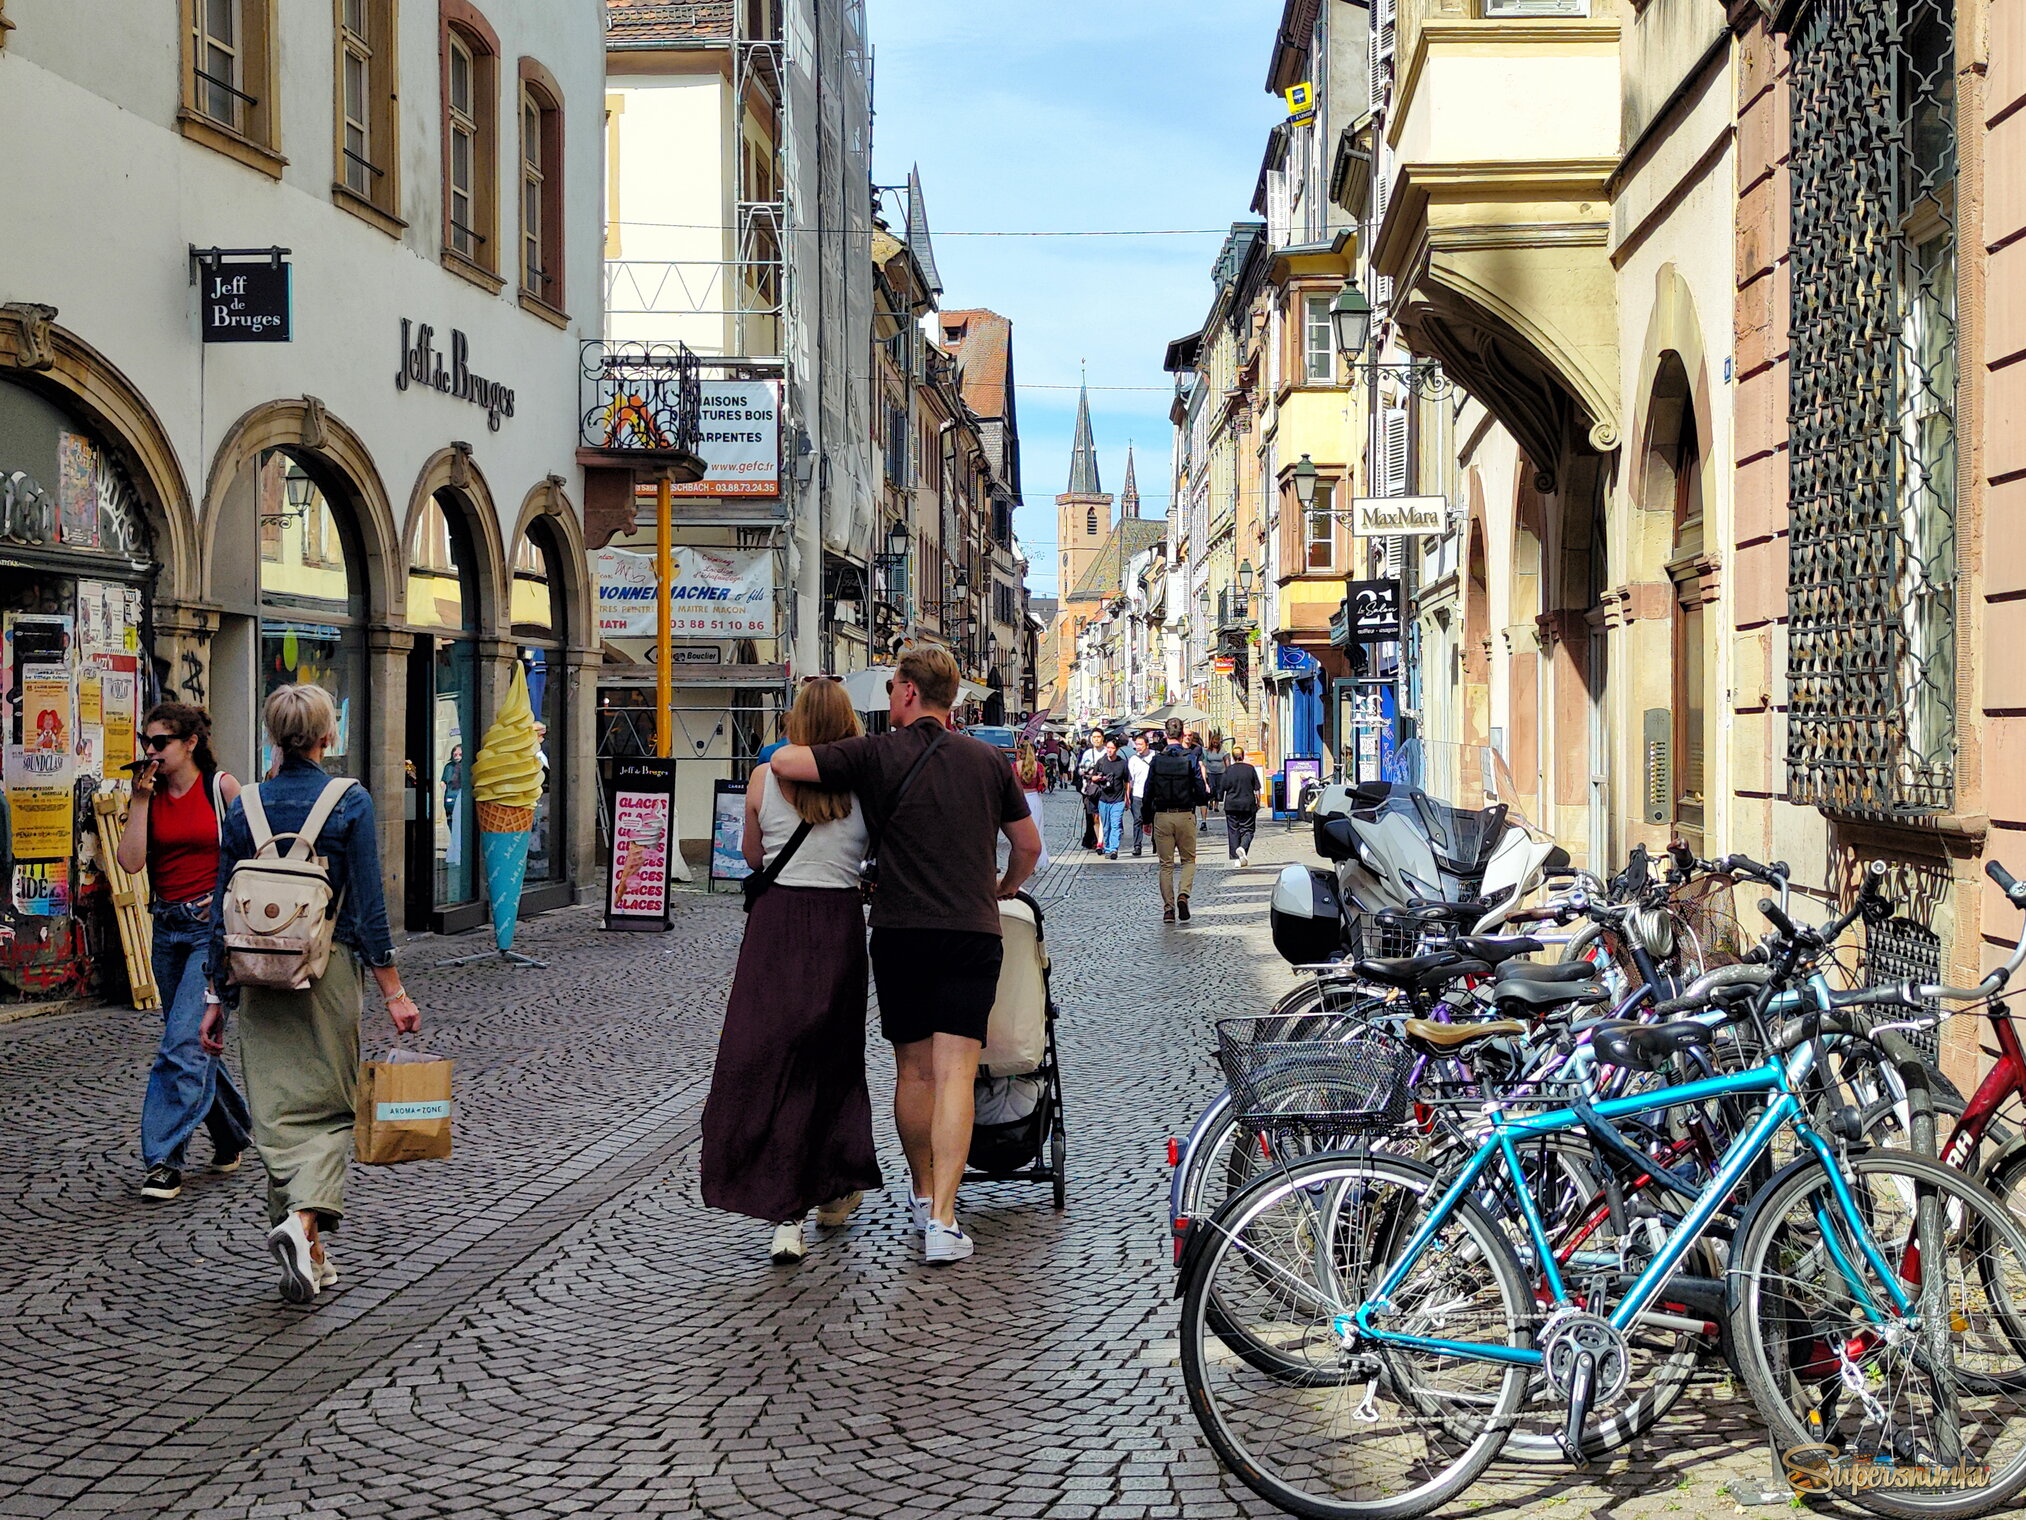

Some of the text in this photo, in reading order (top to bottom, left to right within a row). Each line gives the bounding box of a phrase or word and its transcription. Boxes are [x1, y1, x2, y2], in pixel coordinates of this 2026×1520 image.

[211, 275, 248, 299] Jeff
[230, 298, 246, 310] de
[211, 305, 281, 332] Bruges
[396, 317, 515, 432] Jeff de Bruges
[744, 410, 773, 421] BOIS
[711, 461, 775, 473] www.gefc.fr
[715, 484, 775, 492] 03.88.73.24.35
[1361, 506, 1440, 526] MaxMara
[690, 620, 705, 629] 88
[710, 620, 723, 629] 51
[729, 621, 742, 630] 10
[748, 621, 764, 630] 86
[620, 766, 635, 775] Jeff
[642, 765, 669, 777] Bruges
[615, 899, 662, 910] GLACES
